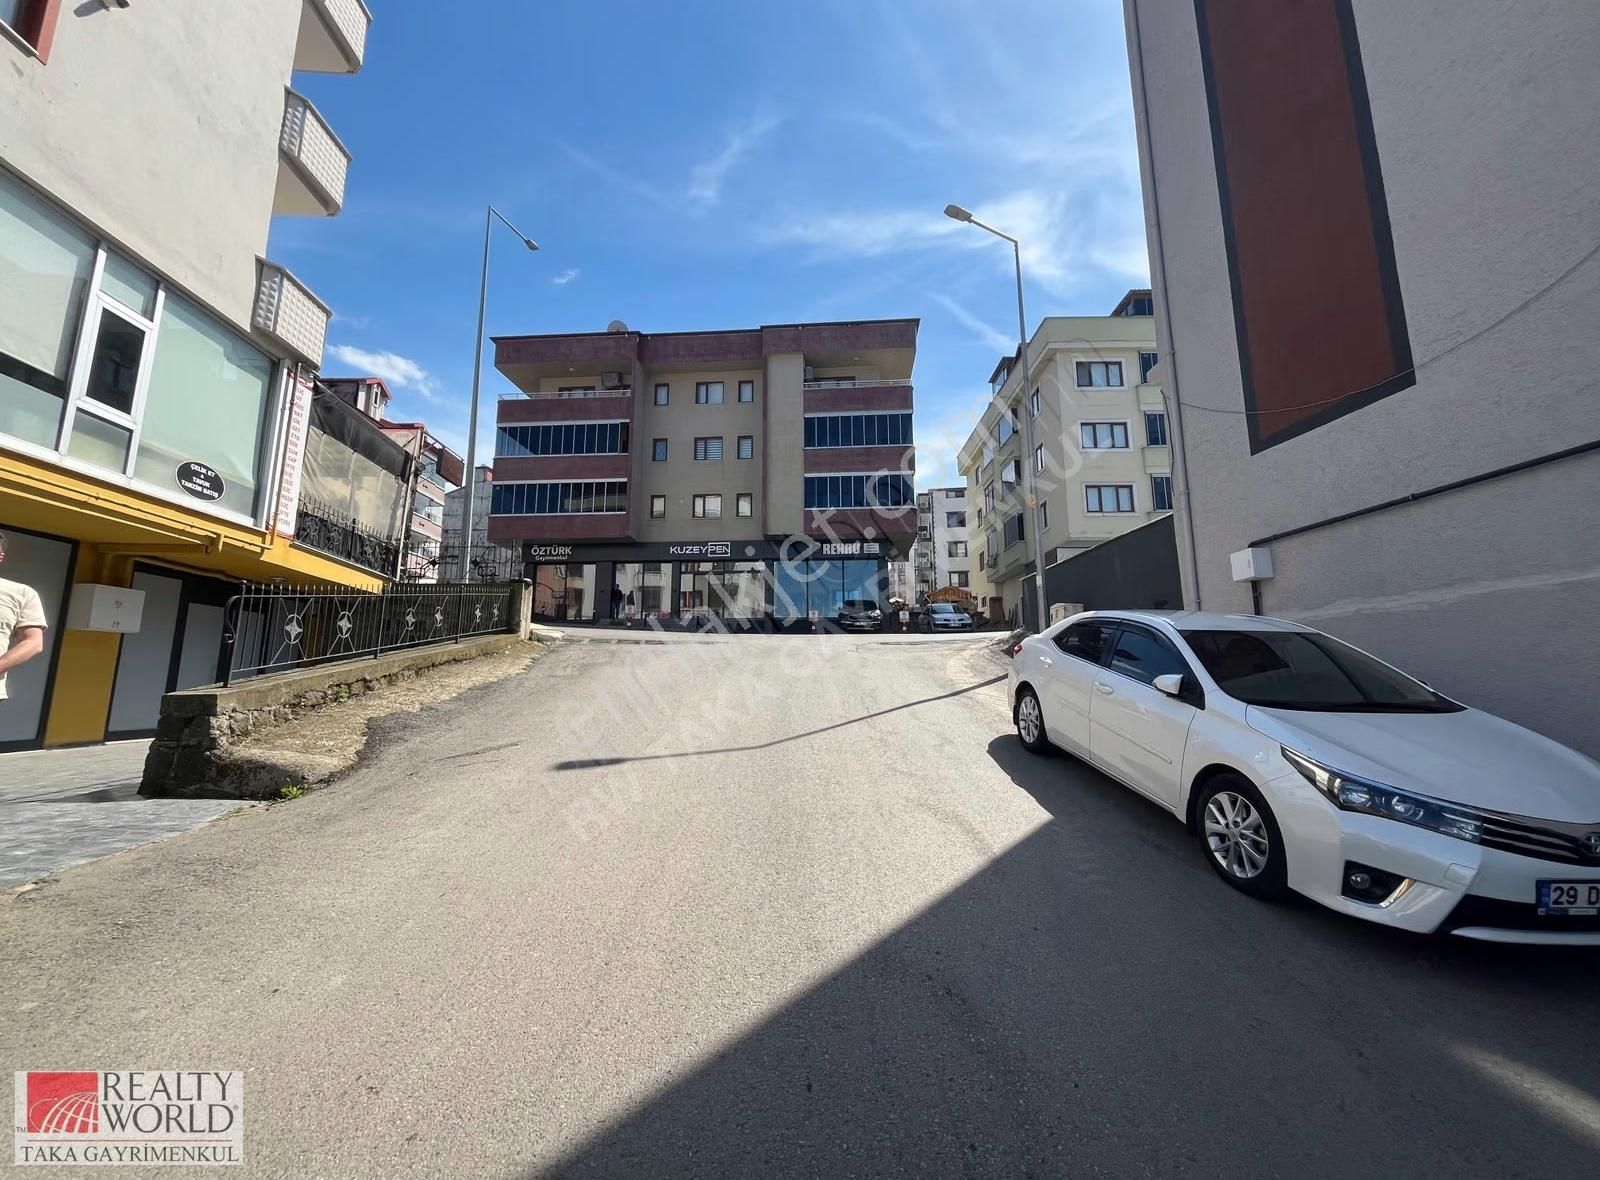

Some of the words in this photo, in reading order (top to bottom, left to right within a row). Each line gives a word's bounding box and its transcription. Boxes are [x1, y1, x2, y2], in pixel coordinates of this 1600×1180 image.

[190, 463, 207, 474] ÇELİK
[207, 470, 216, 478] ET
[192, 476, 210, 488] TAVUK
[531, 544, 572, 556] ÖZTÜRK
[822, 543, 861, 555] REHAU
[1552, 886, 1578, 906] 29
